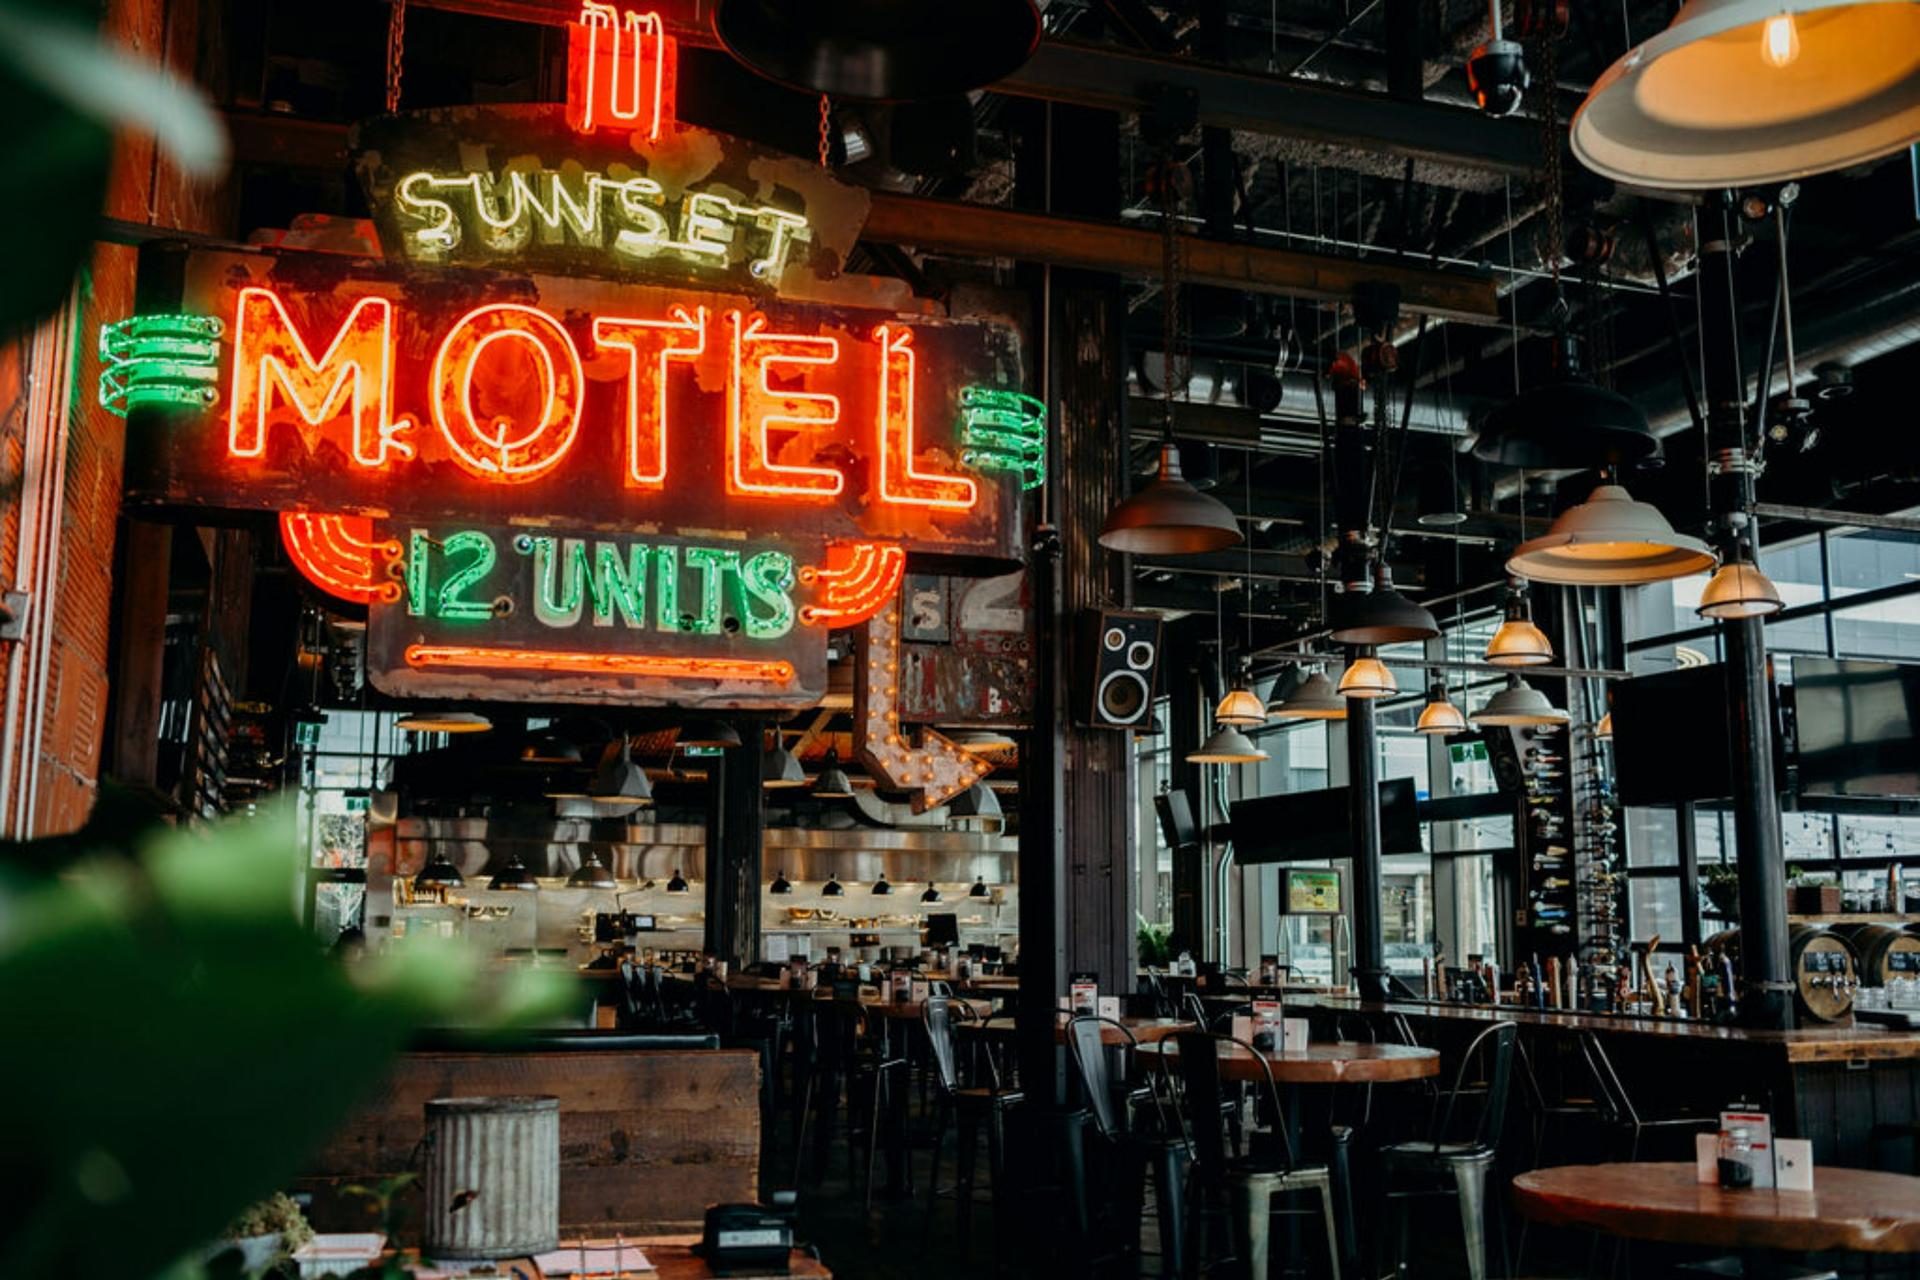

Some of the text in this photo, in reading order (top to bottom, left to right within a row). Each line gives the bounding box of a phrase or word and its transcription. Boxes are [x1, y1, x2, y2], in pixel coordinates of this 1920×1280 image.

[395, 171, 812, 285] SUNSET
[227, 287, 978, 508] MOTEL
[406, 528, 798, 640] 12 UNITS
